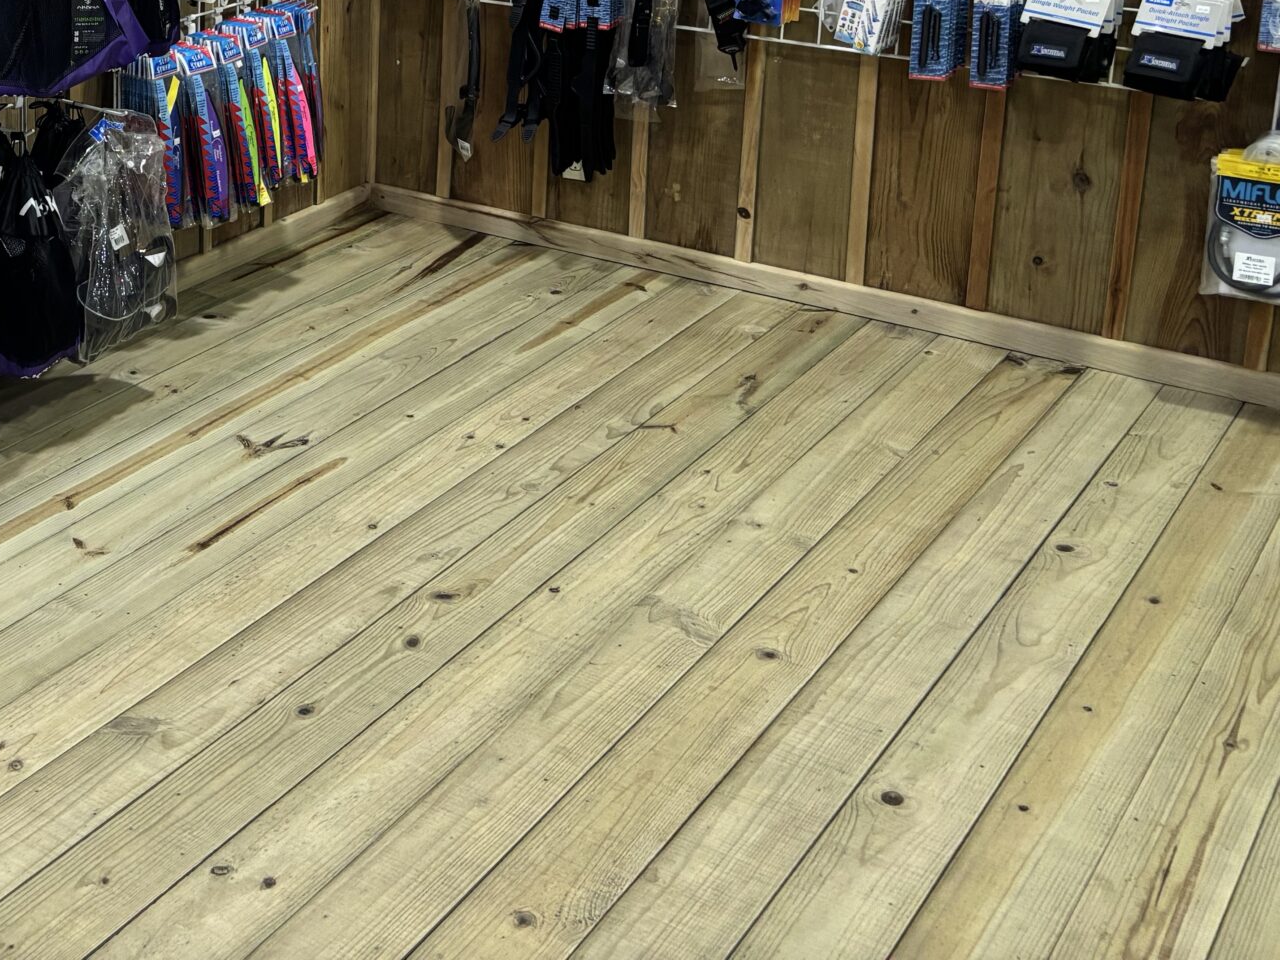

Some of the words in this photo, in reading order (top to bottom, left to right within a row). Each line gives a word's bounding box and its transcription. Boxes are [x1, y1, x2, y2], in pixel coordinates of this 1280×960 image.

[1051, 2, 1076, 14] Weight
[1076, 6, 1100, 17] Pocket
[1147, 7, 1189, 20] Quick-Attach
[1190, 12, 1210, 23] Single
[1154, 15, 1179, 26] Weight
[1179, 18, 1201, 29] Pocket
[1223, 198, 1261, 207] LIGHTWEIGHT
[1230, 206, 1280, 222] XTREM
